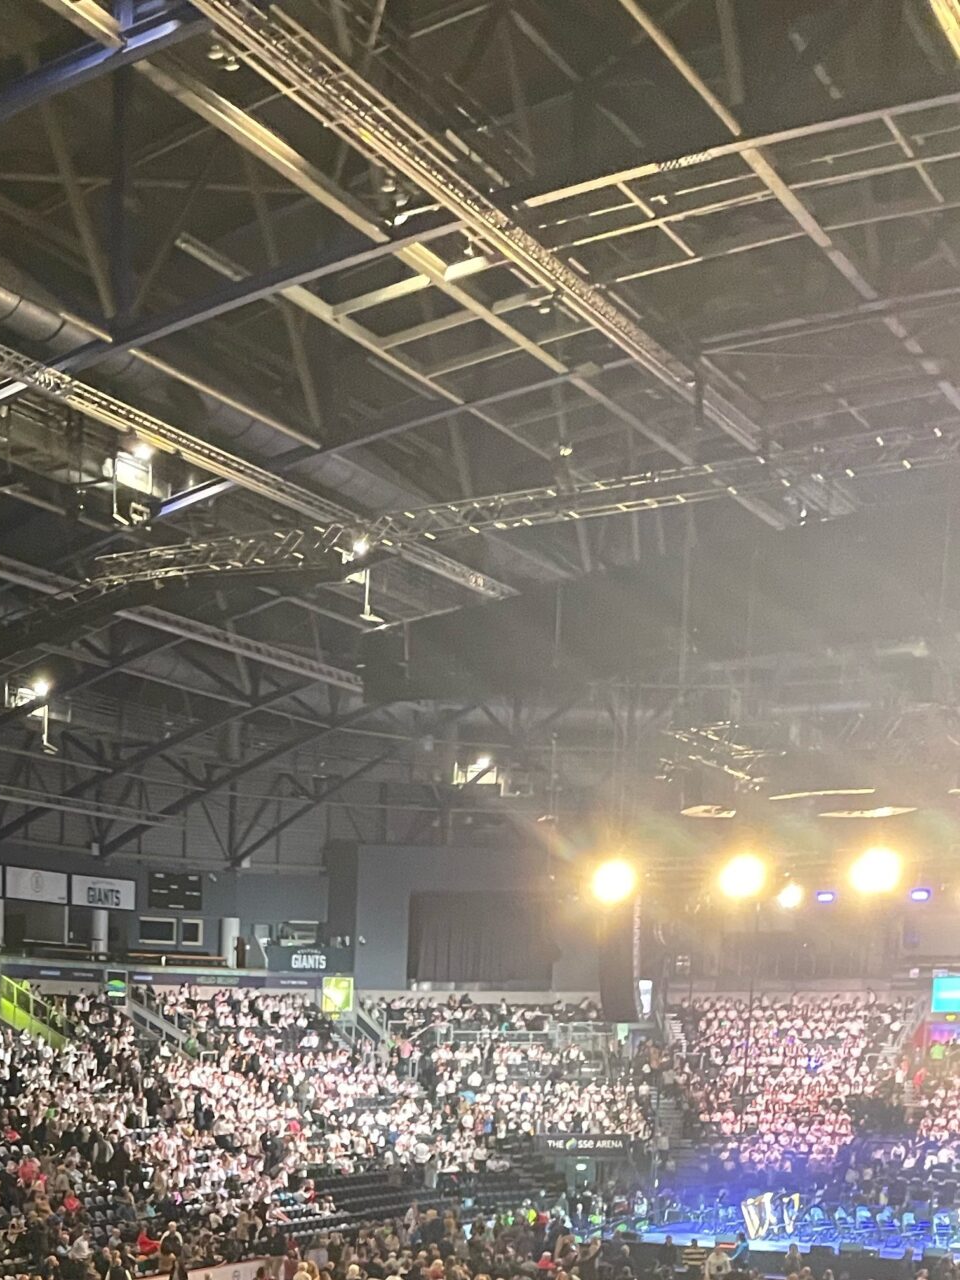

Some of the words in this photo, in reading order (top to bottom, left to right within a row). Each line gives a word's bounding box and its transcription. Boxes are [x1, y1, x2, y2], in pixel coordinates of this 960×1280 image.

[87, 886, 121, 907] GIANTS
[291, 954, 327, 969] GIANTS
[547, 1139, 564, 1149] THE
[595, 1139, 623, 1149] ARENA
